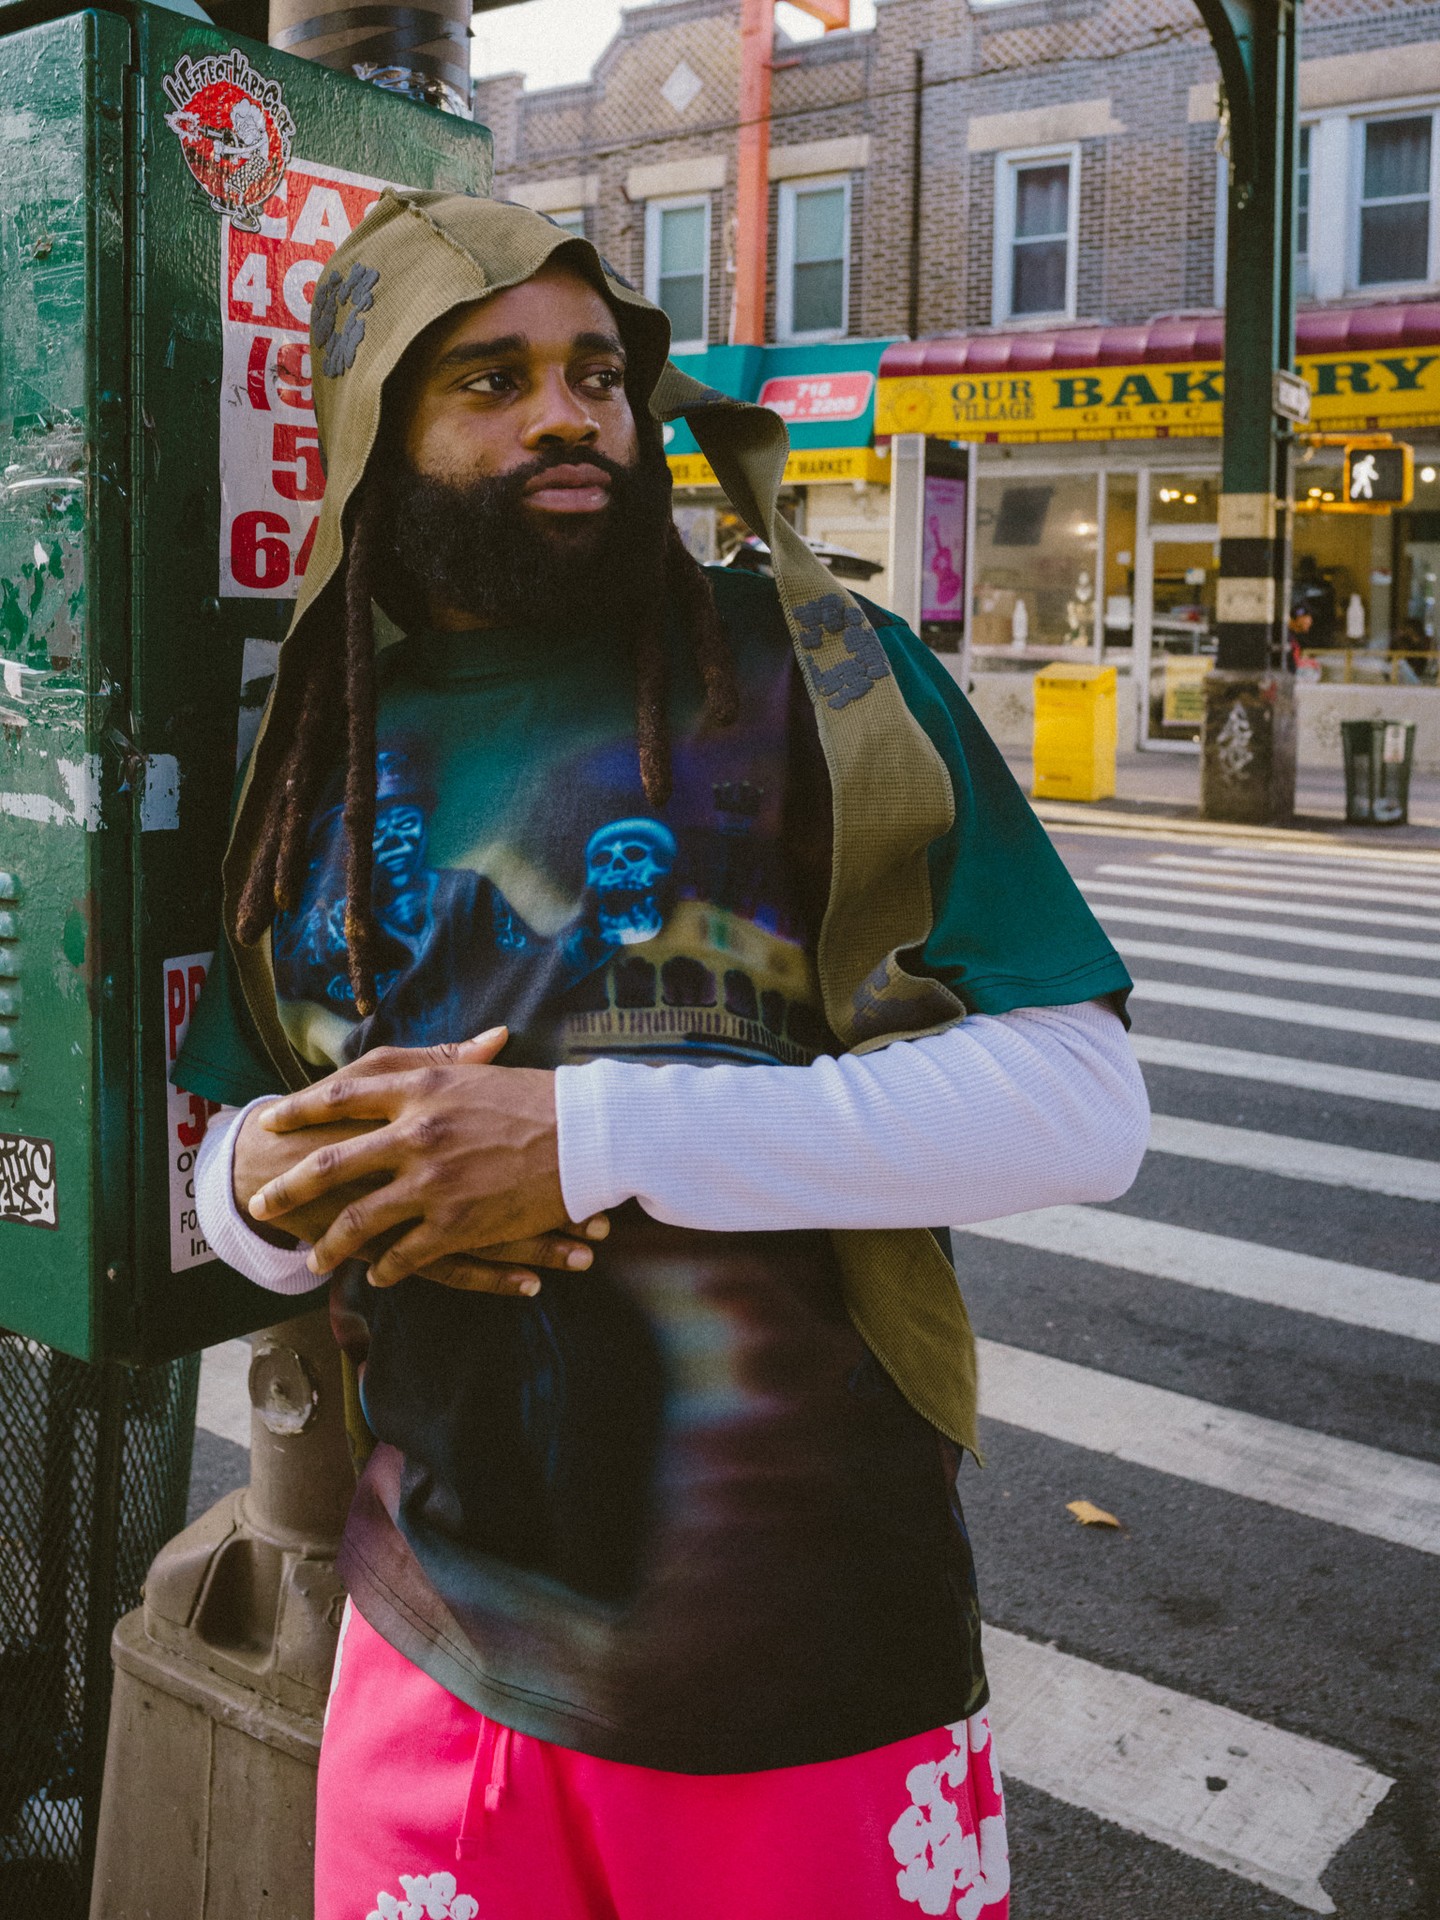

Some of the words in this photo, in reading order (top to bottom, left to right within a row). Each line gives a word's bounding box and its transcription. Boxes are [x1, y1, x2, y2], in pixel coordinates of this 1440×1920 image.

[951, 379, 1033, 400] OUR
[1053, 354, 1440, 409] BAKRY
[952, 401, 1036, 422] VILLAGE
[1083, 406, 1202, 424] GROC
[271, 422, 328, 502] 5
[799, 458, 853, 474] MARKET
